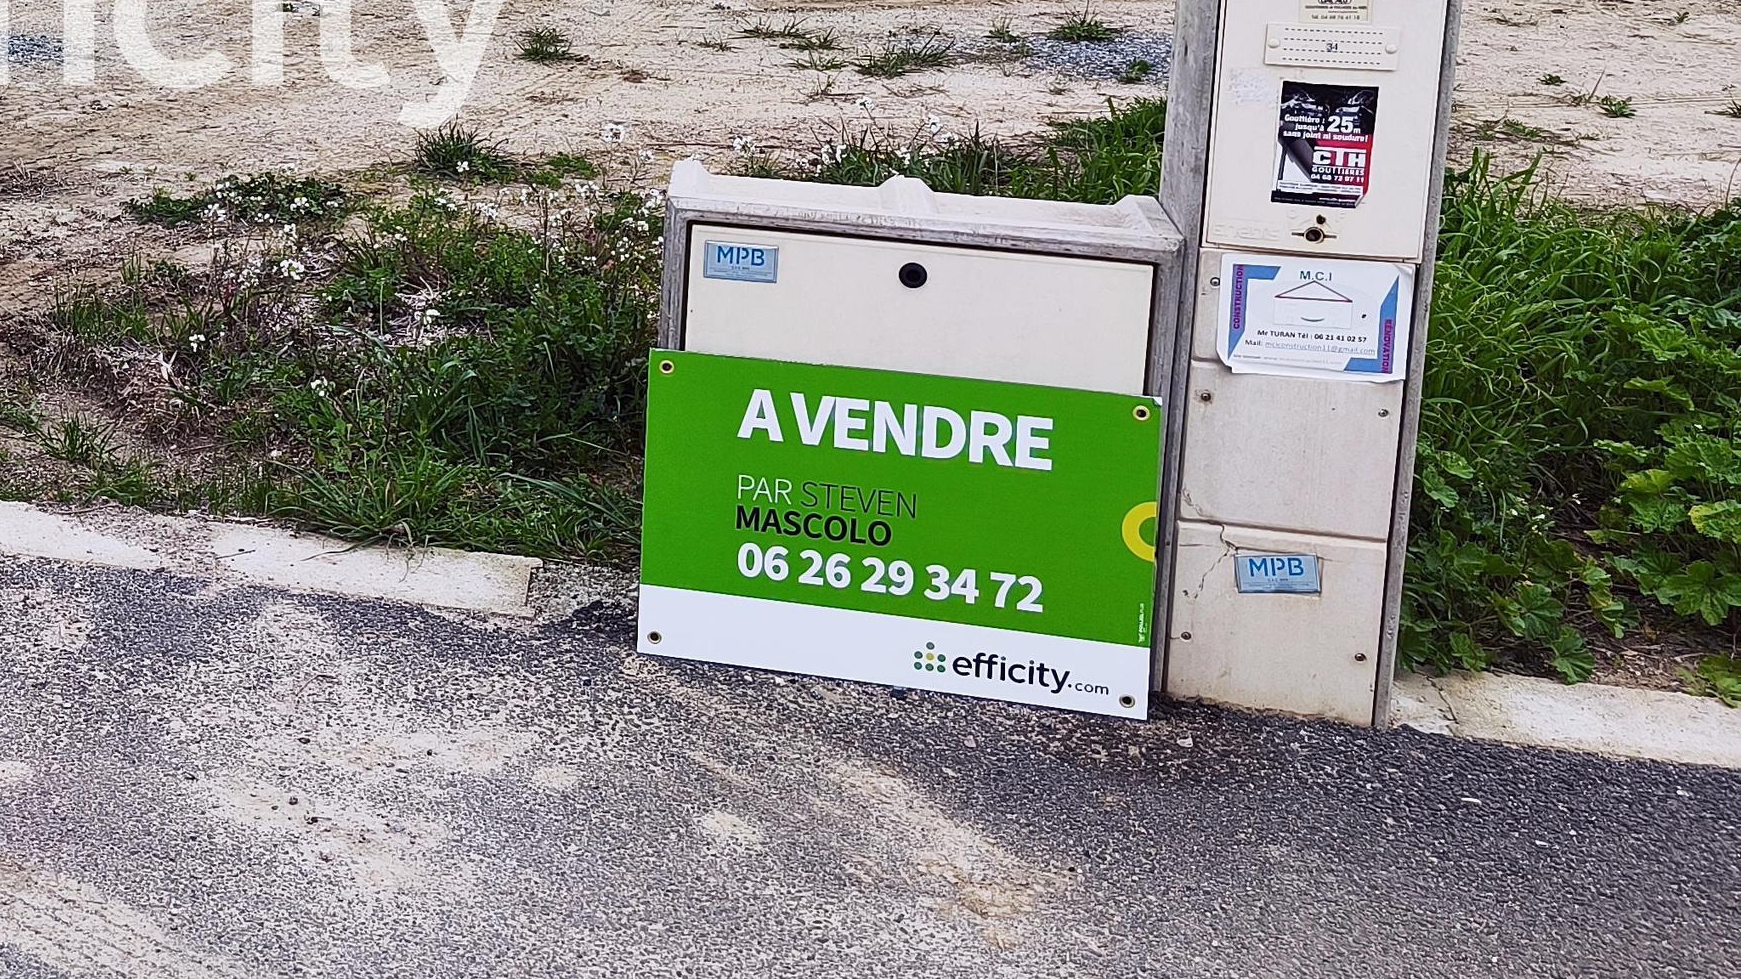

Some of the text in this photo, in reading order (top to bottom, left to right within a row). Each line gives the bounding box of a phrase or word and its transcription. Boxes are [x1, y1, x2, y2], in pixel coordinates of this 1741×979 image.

[1326, 42, 1338, 52] 34
[1302, 131, 1321, 139] joint
[1313, 146, 1366, 168] CTH
[717, 245, 765, 266] MPB
[1299, 270, 1332, 282] M.C.I
[1233, 264, 1244, 329] CONSTRUCTION
[1270, 330, 1296, 338] TURAN
[736, 388, 1054, 471] A VENDRE
[736, 474, 918, 519] PAR STEVEN
[735, 504, 892, 547] MASCOLO
[737, 542, 1044, 613] 06 26 29 34 72
[1248, 557, 1304, 577] MPB
[952, 652, 1110, 696] efficity.com
